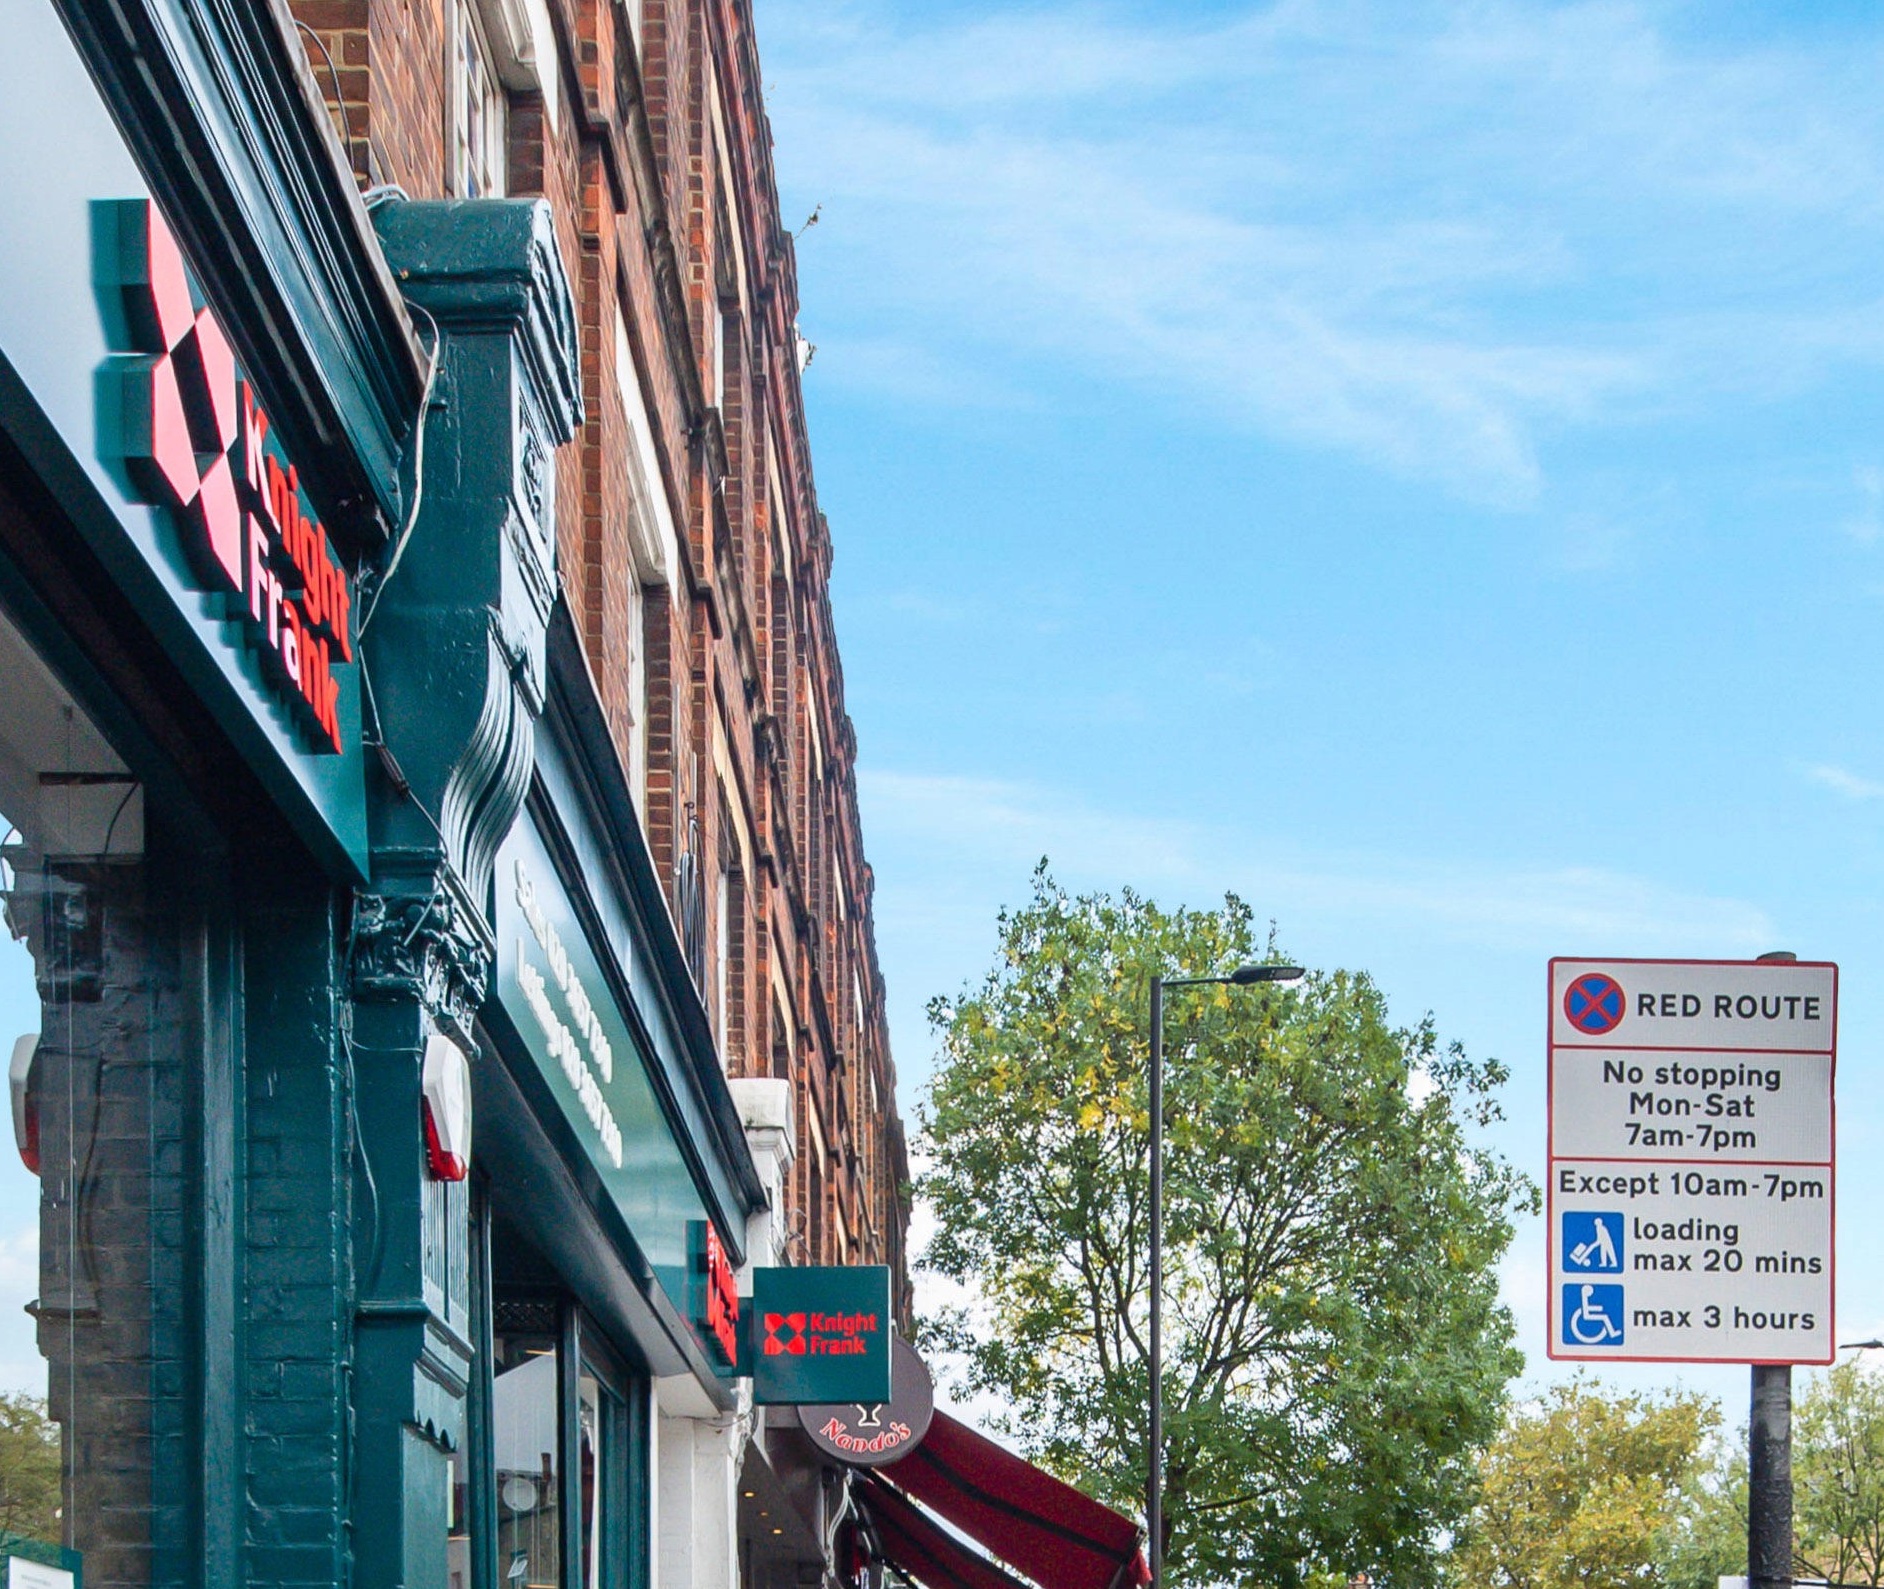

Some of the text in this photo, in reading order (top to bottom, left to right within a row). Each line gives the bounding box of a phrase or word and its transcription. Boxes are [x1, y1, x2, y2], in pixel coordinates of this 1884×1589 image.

[243, 379, 352, 663] Knight
[249, 511, 342, 755] Frank
[1637, 993, 1821, 1021] RED ROUTE
[1603, 1060, 1782, 1092] No stopping
[1628, 1092, 1756, 1118] Mon-Sat
[1624, 1123, 1757, 1152] 7am-7pm
[1559, 1170, 1660, 1198] Except
[1633, 1216, 1739, 1246] loading
[1633, 1250, 1823, 1275] max 20 mins
[810, 1312, 877, 1336] Knight
[1633, 1305, 1816, 1331] max 3 hours
[810, 1335, 867, 1355] Frank
[819, 1417, 912, 1453] Nando's
